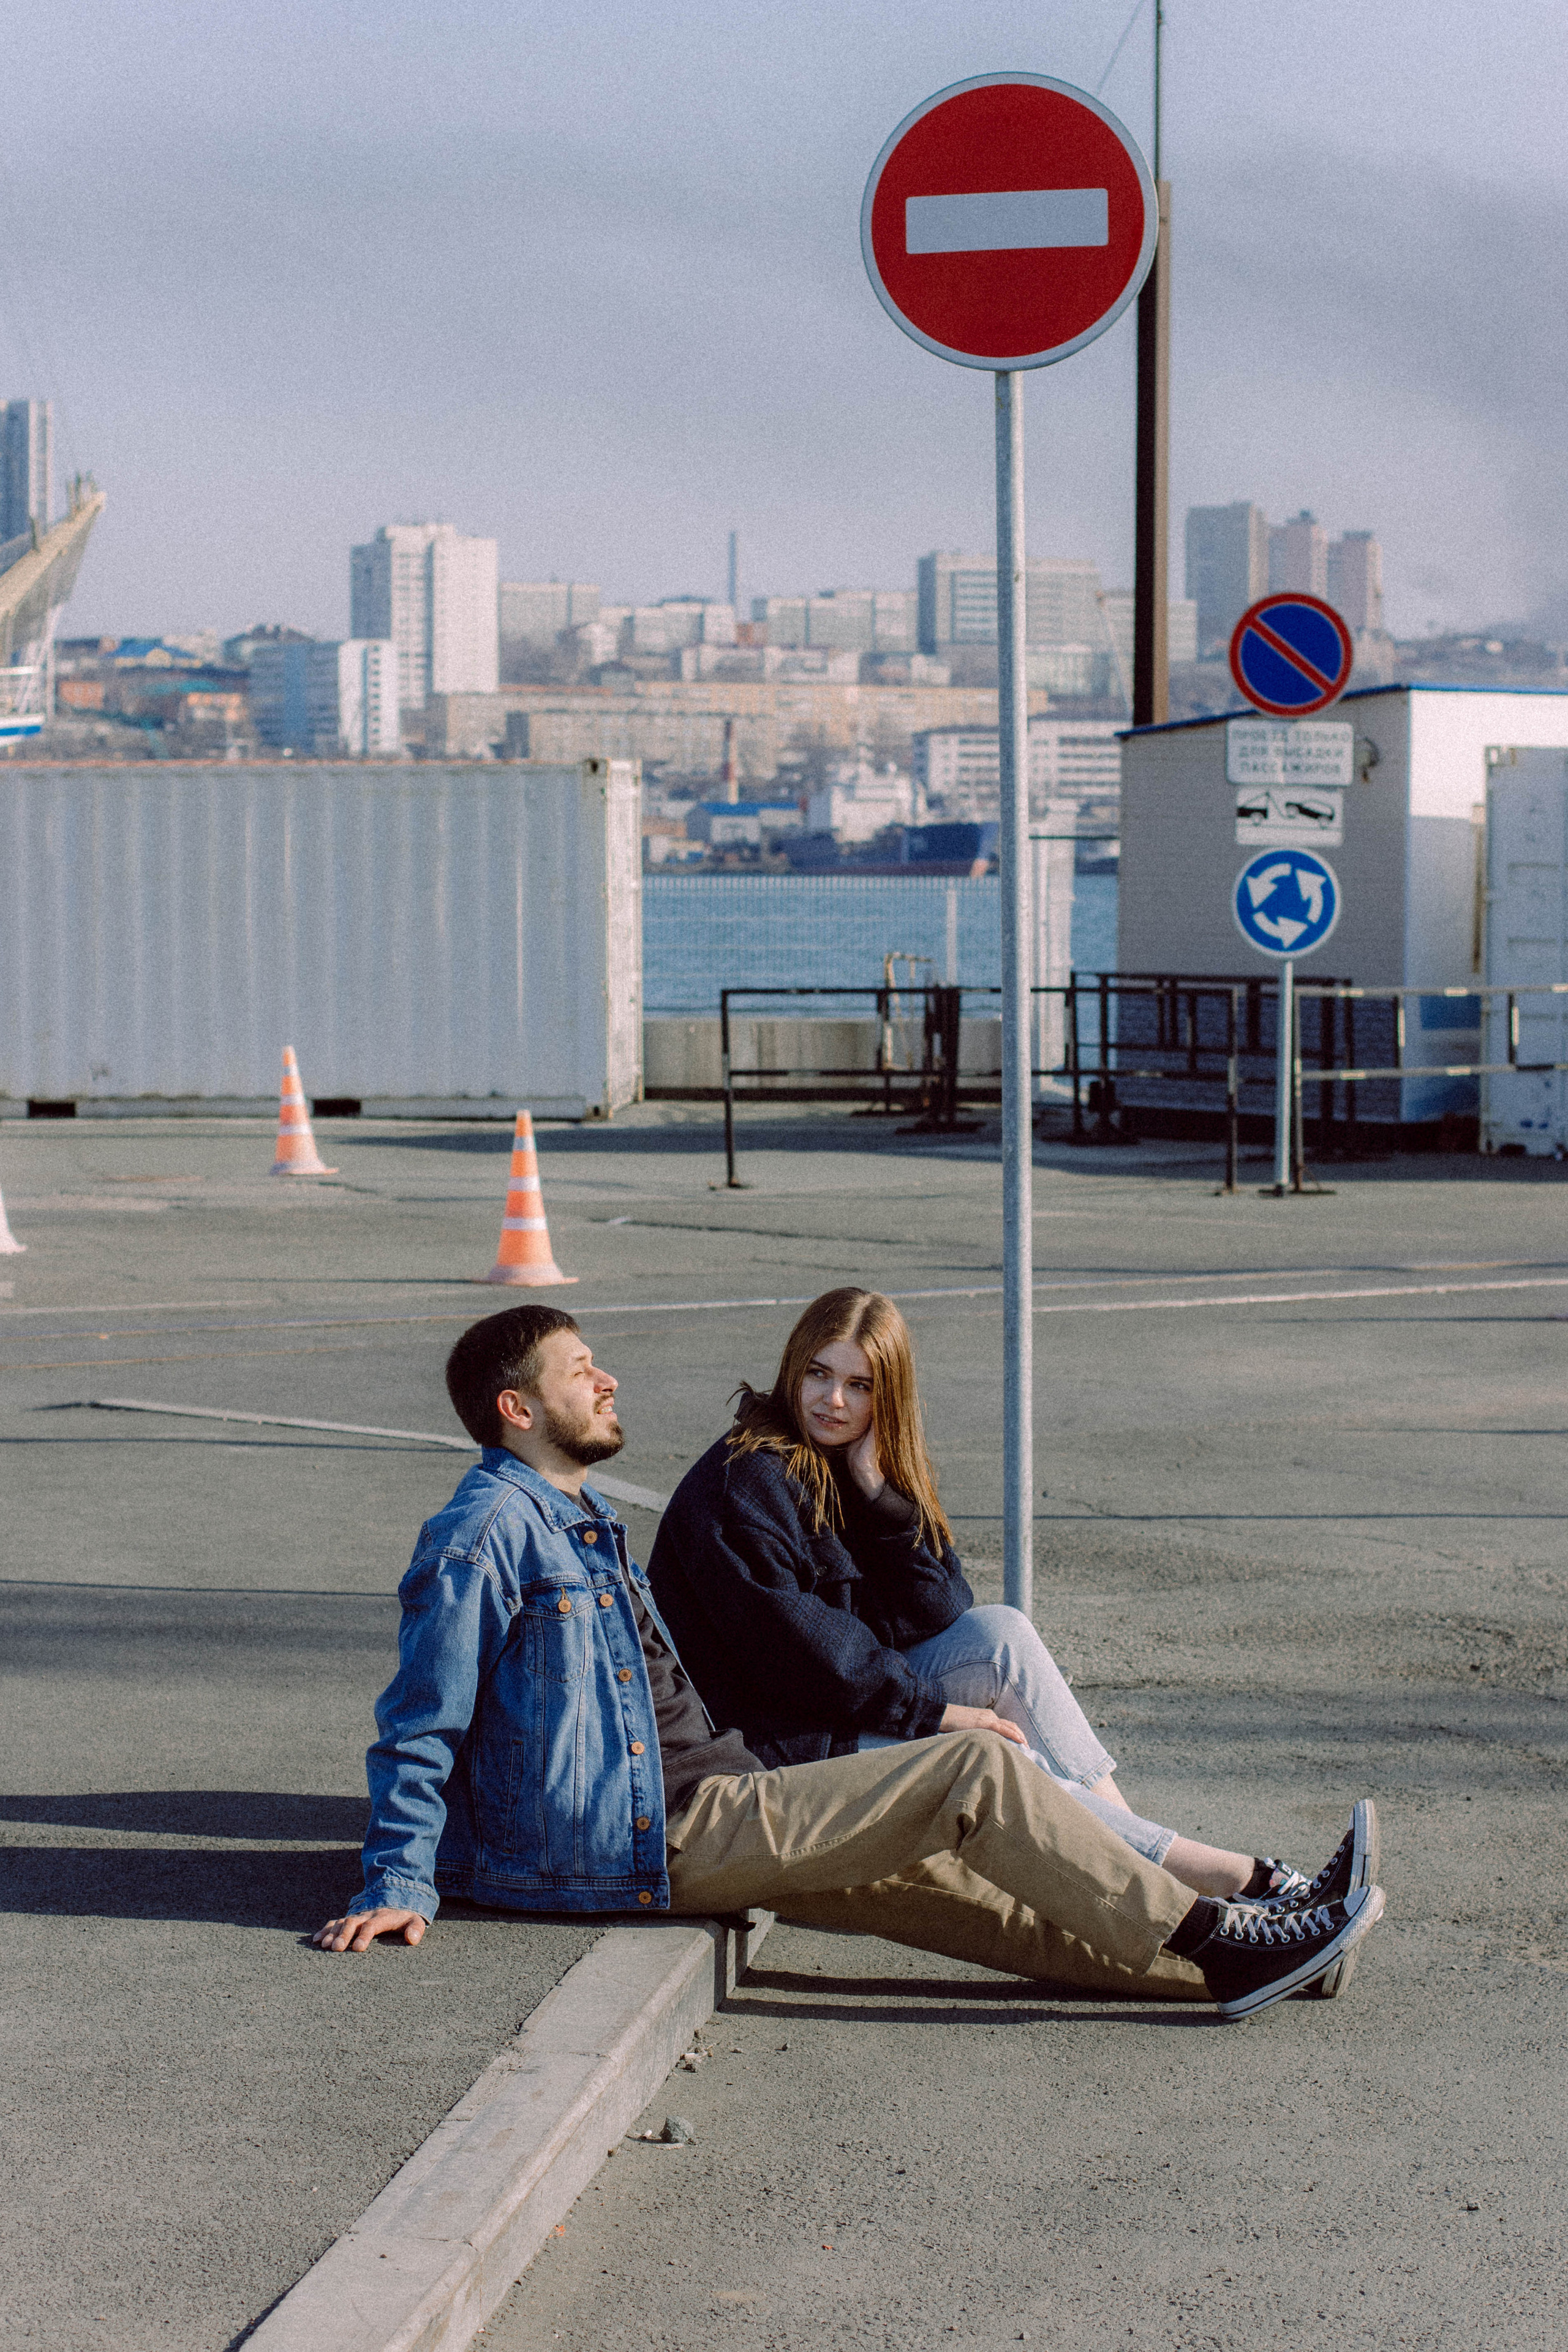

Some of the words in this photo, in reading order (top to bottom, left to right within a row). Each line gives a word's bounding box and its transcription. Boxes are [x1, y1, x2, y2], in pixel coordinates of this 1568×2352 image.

[1295, 731, 1350, 742] ТОЛЬКО
[1238, 746, 1268, 758] ДЛЯ
[1240, 762, 1341, 774] ПАССАЖИРОВ
